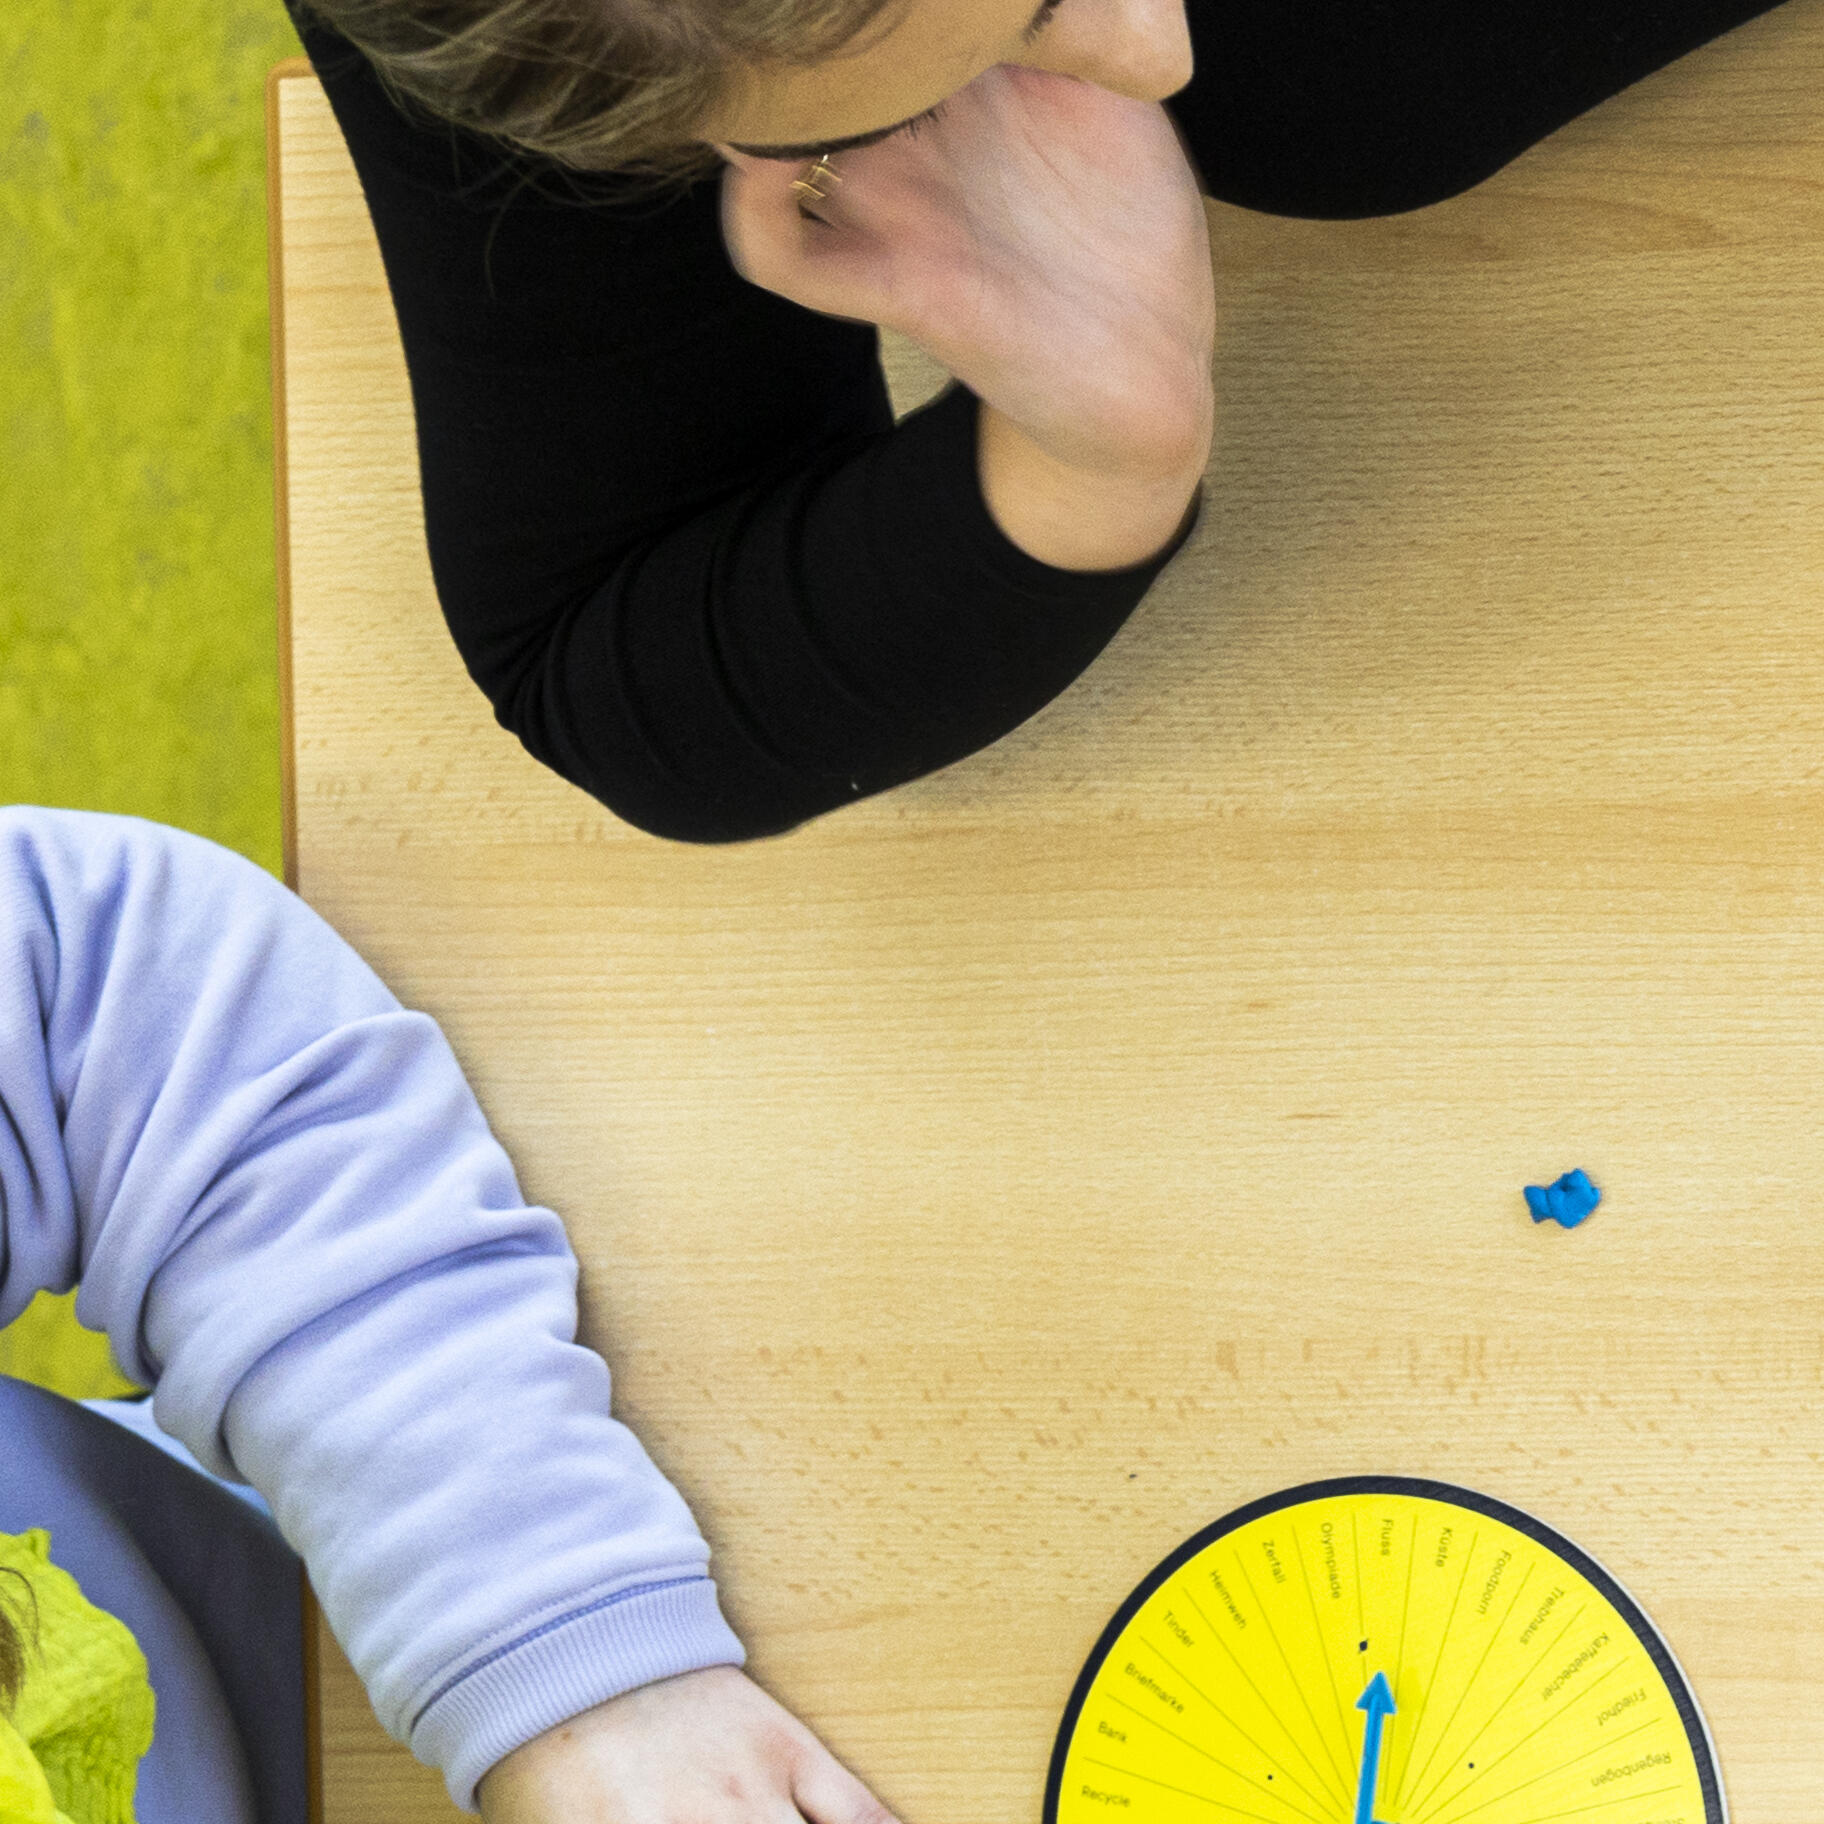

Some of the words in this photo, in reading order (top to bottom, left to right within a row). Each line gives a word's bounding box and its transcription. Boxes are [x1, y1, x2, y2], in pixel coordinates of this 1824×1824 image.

[1381, 1519, 1394, 1556] Fluss
[1262, 1540, 1286, 1584] Zerfall
[1321, 1522, 1341, 1599] Olympiade
[1477, 1550, 1512, 1615] Foodporn
[1209, 1570, 1246, 1629] Heimweh
[1163, 1610, 1194, 1647] Tinder
[1124, 1662, 1184, 1713] Briefmarke
[1542, 1632, 1610, 1700] Kaffeebecher
[1597, 1688, 1647, 1726] Friedhof
[1591, 1752, 1672, 1787] Regenbogen
[1081, 1785, 1130, 1808] Recycle
